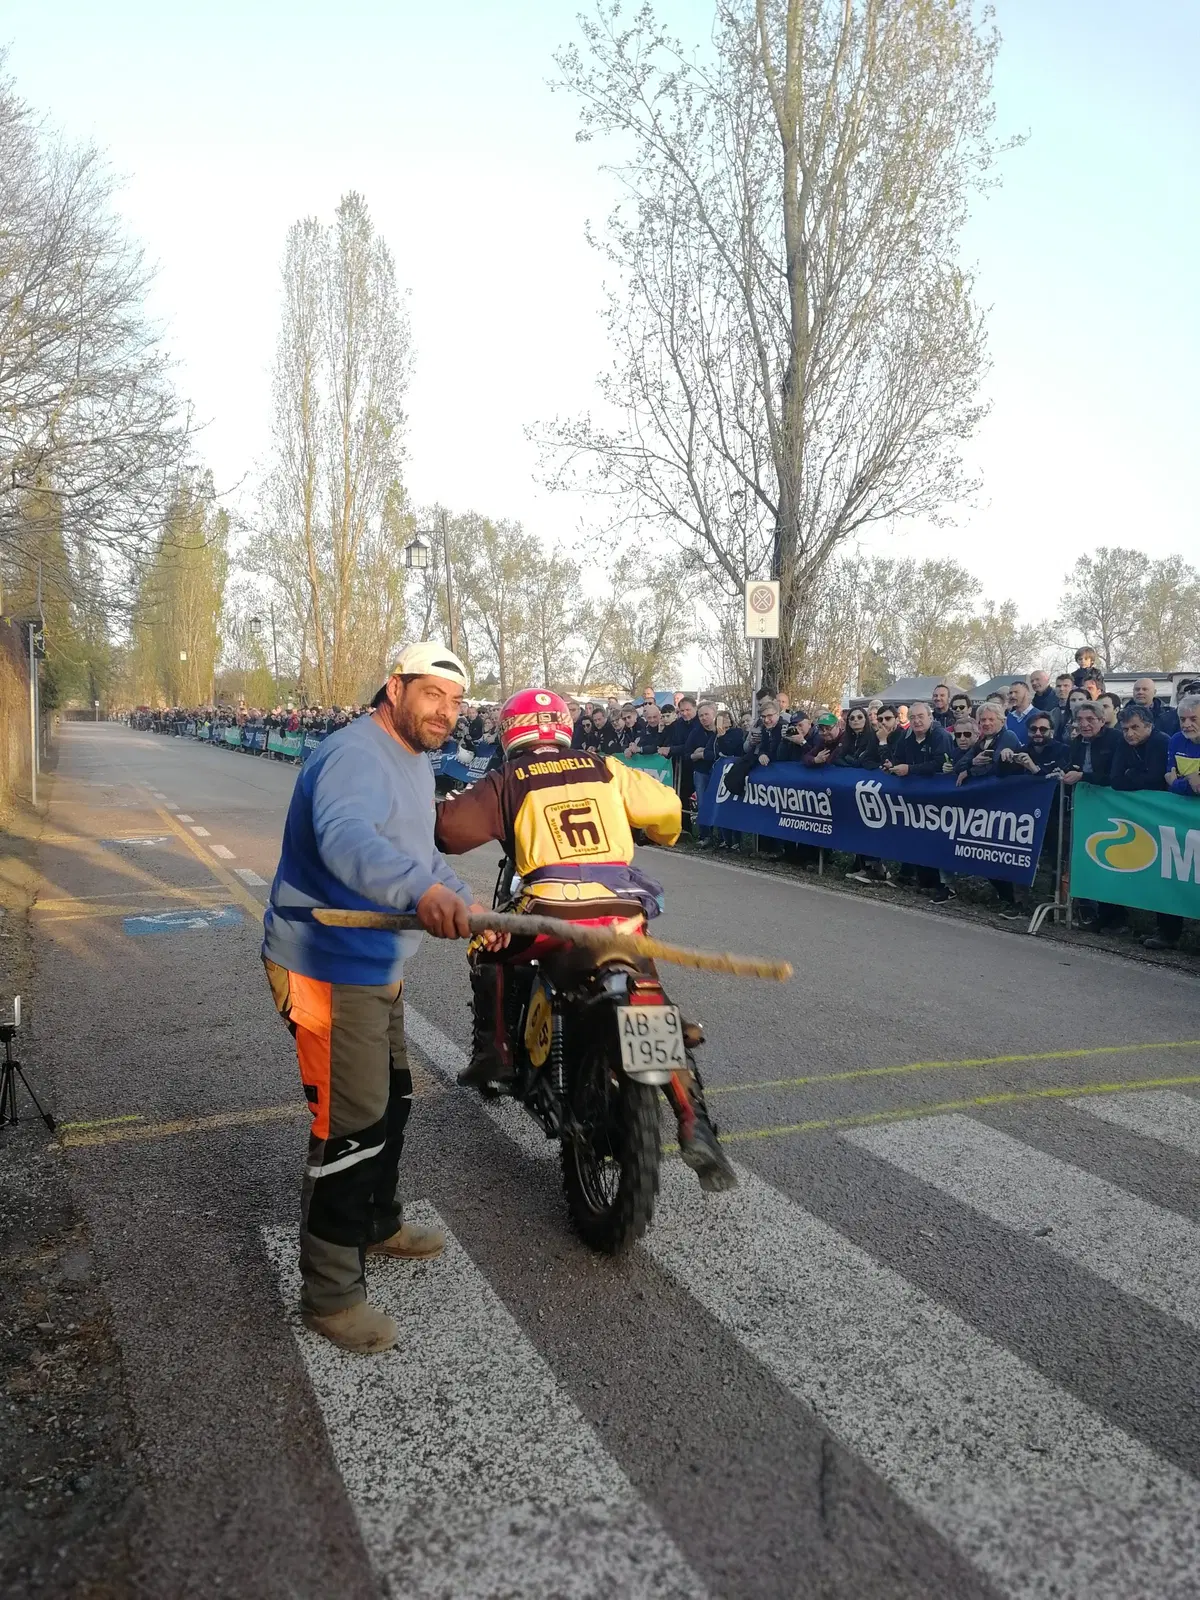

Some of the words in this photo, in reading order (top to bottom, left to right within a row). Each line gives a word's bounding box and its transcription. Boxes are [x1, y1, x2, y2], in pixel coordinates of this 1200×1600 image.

[515, 767, 529, 780] U.
[528, 757, 596, 776] SIGNORELLI
[778, 816, 833, 835] MOTORCYCLES
[885, 793, 1036, 845] Husqvarna
[954, 844, 1032, 868] MOTORCYCLES
[624, 1012, 650, 1037] AB
[664, 1012, 678, 1035] 9
[627, 1038, 682, 1066] 1954
